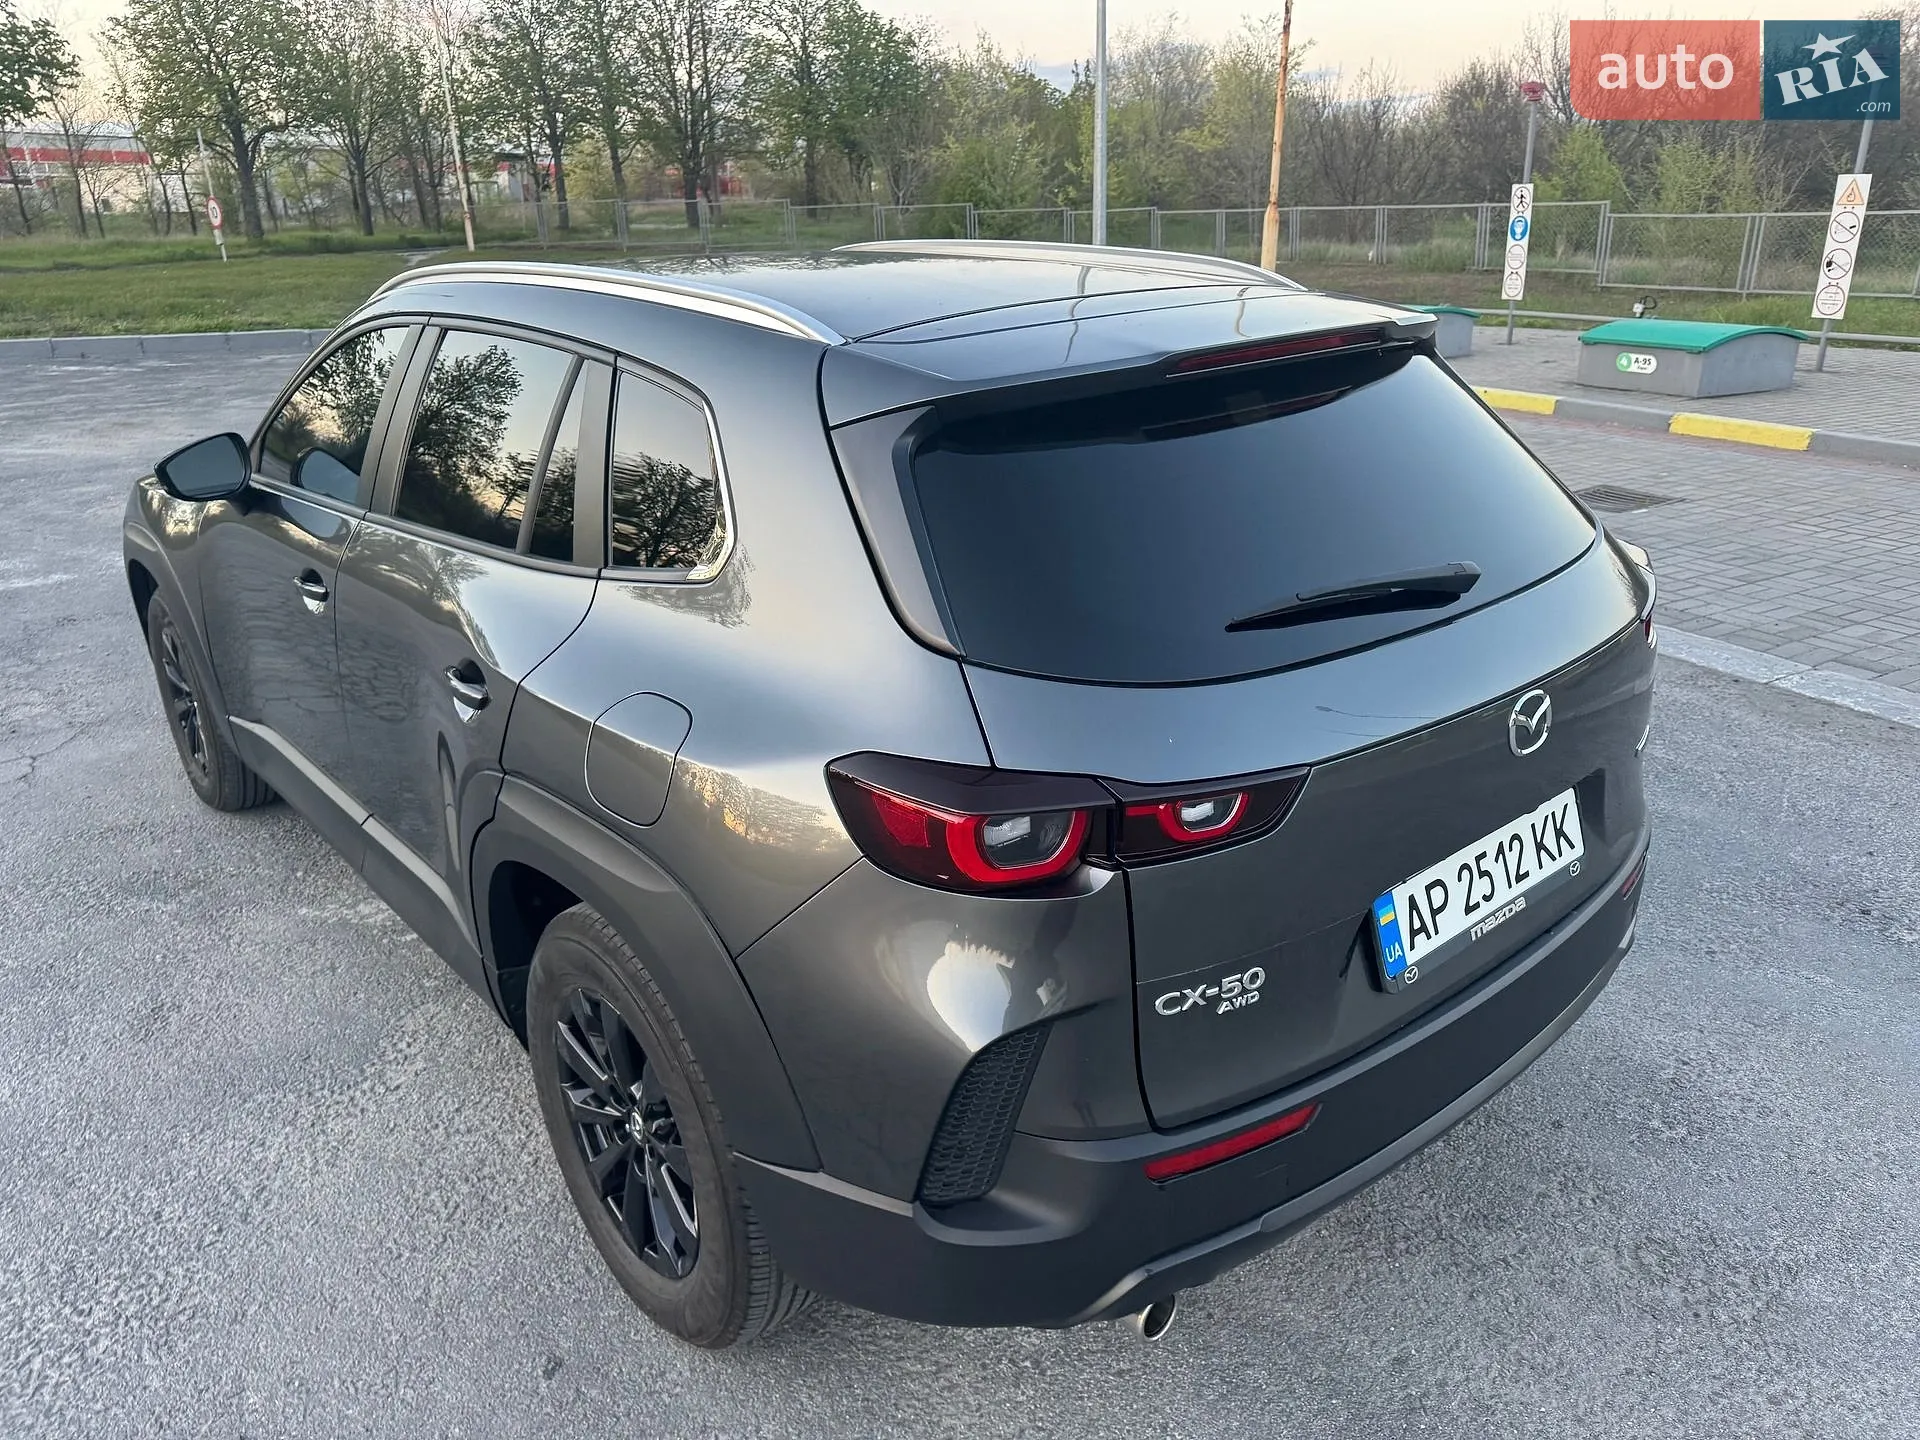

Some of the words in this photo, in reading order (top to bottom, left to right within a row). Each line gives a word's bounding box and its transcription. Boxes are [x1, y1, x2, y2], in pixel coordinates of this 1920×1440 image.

[1407, 878, 1449, 952] AP
[1457, 833, 1530, 917] 2512
[1530, 802, 1576, 870] KK
[1385, 942, 1403, 963] UA
[1154, 966, 1266, 1016] CX-50
[1215, 990, 1260, 1015] AWD
